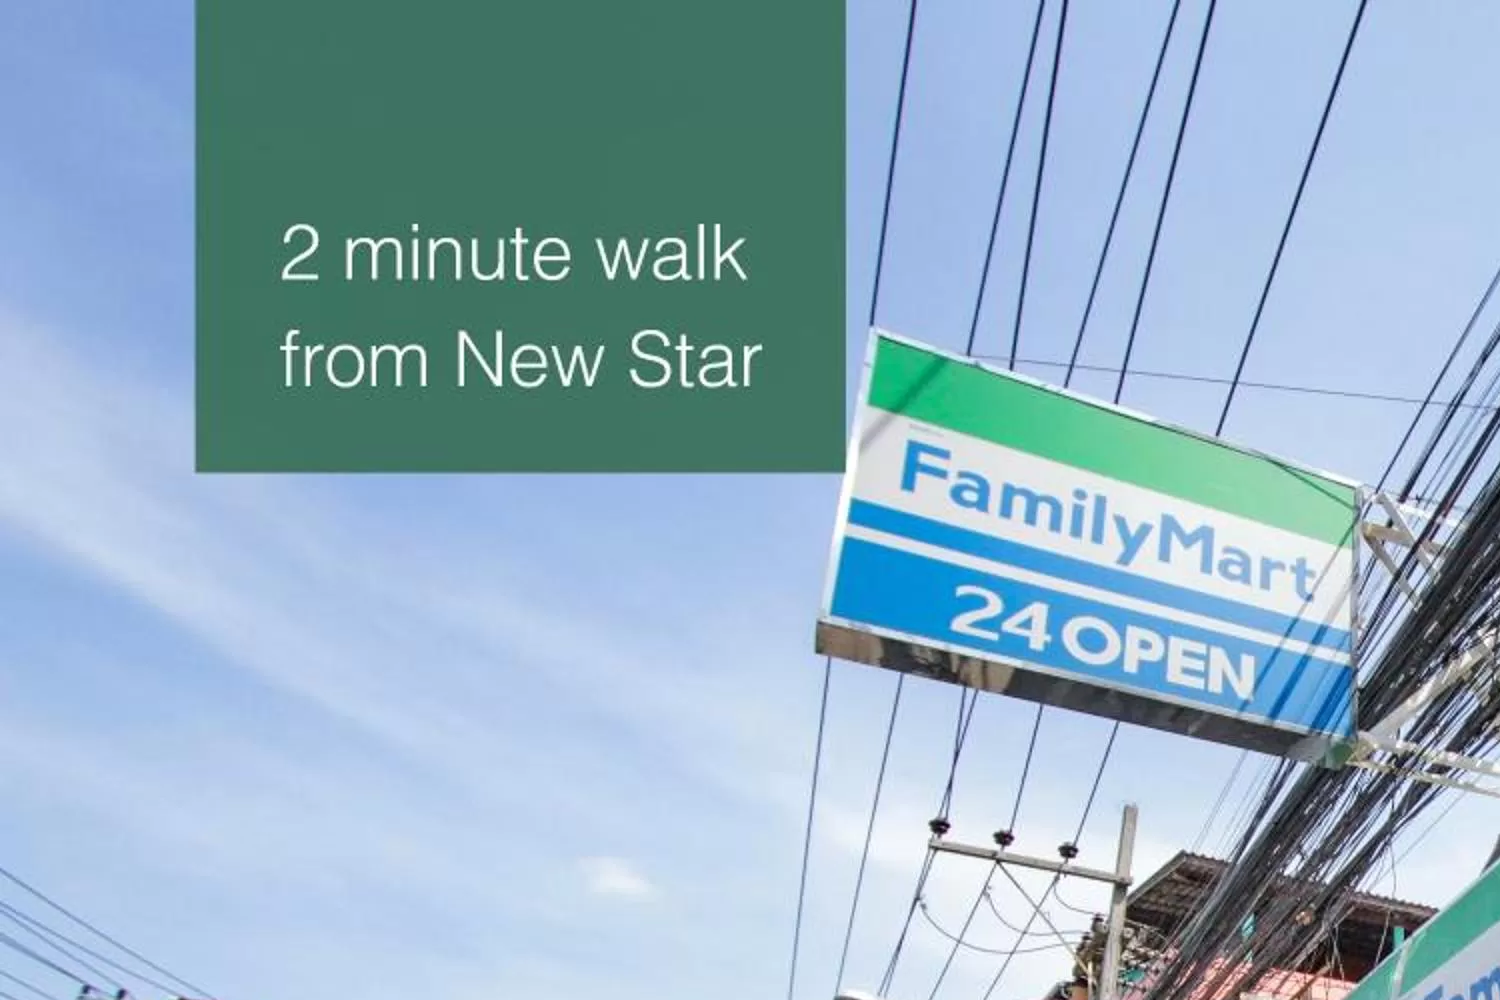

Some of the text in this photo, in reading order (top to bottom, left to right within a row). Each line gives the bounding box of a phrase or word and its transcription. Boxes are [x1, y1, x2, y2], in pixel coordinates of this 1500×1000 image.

[899, 437, 1318, 604] FamilyMart
[950, 584, 1257, 702] 24 OPEN
